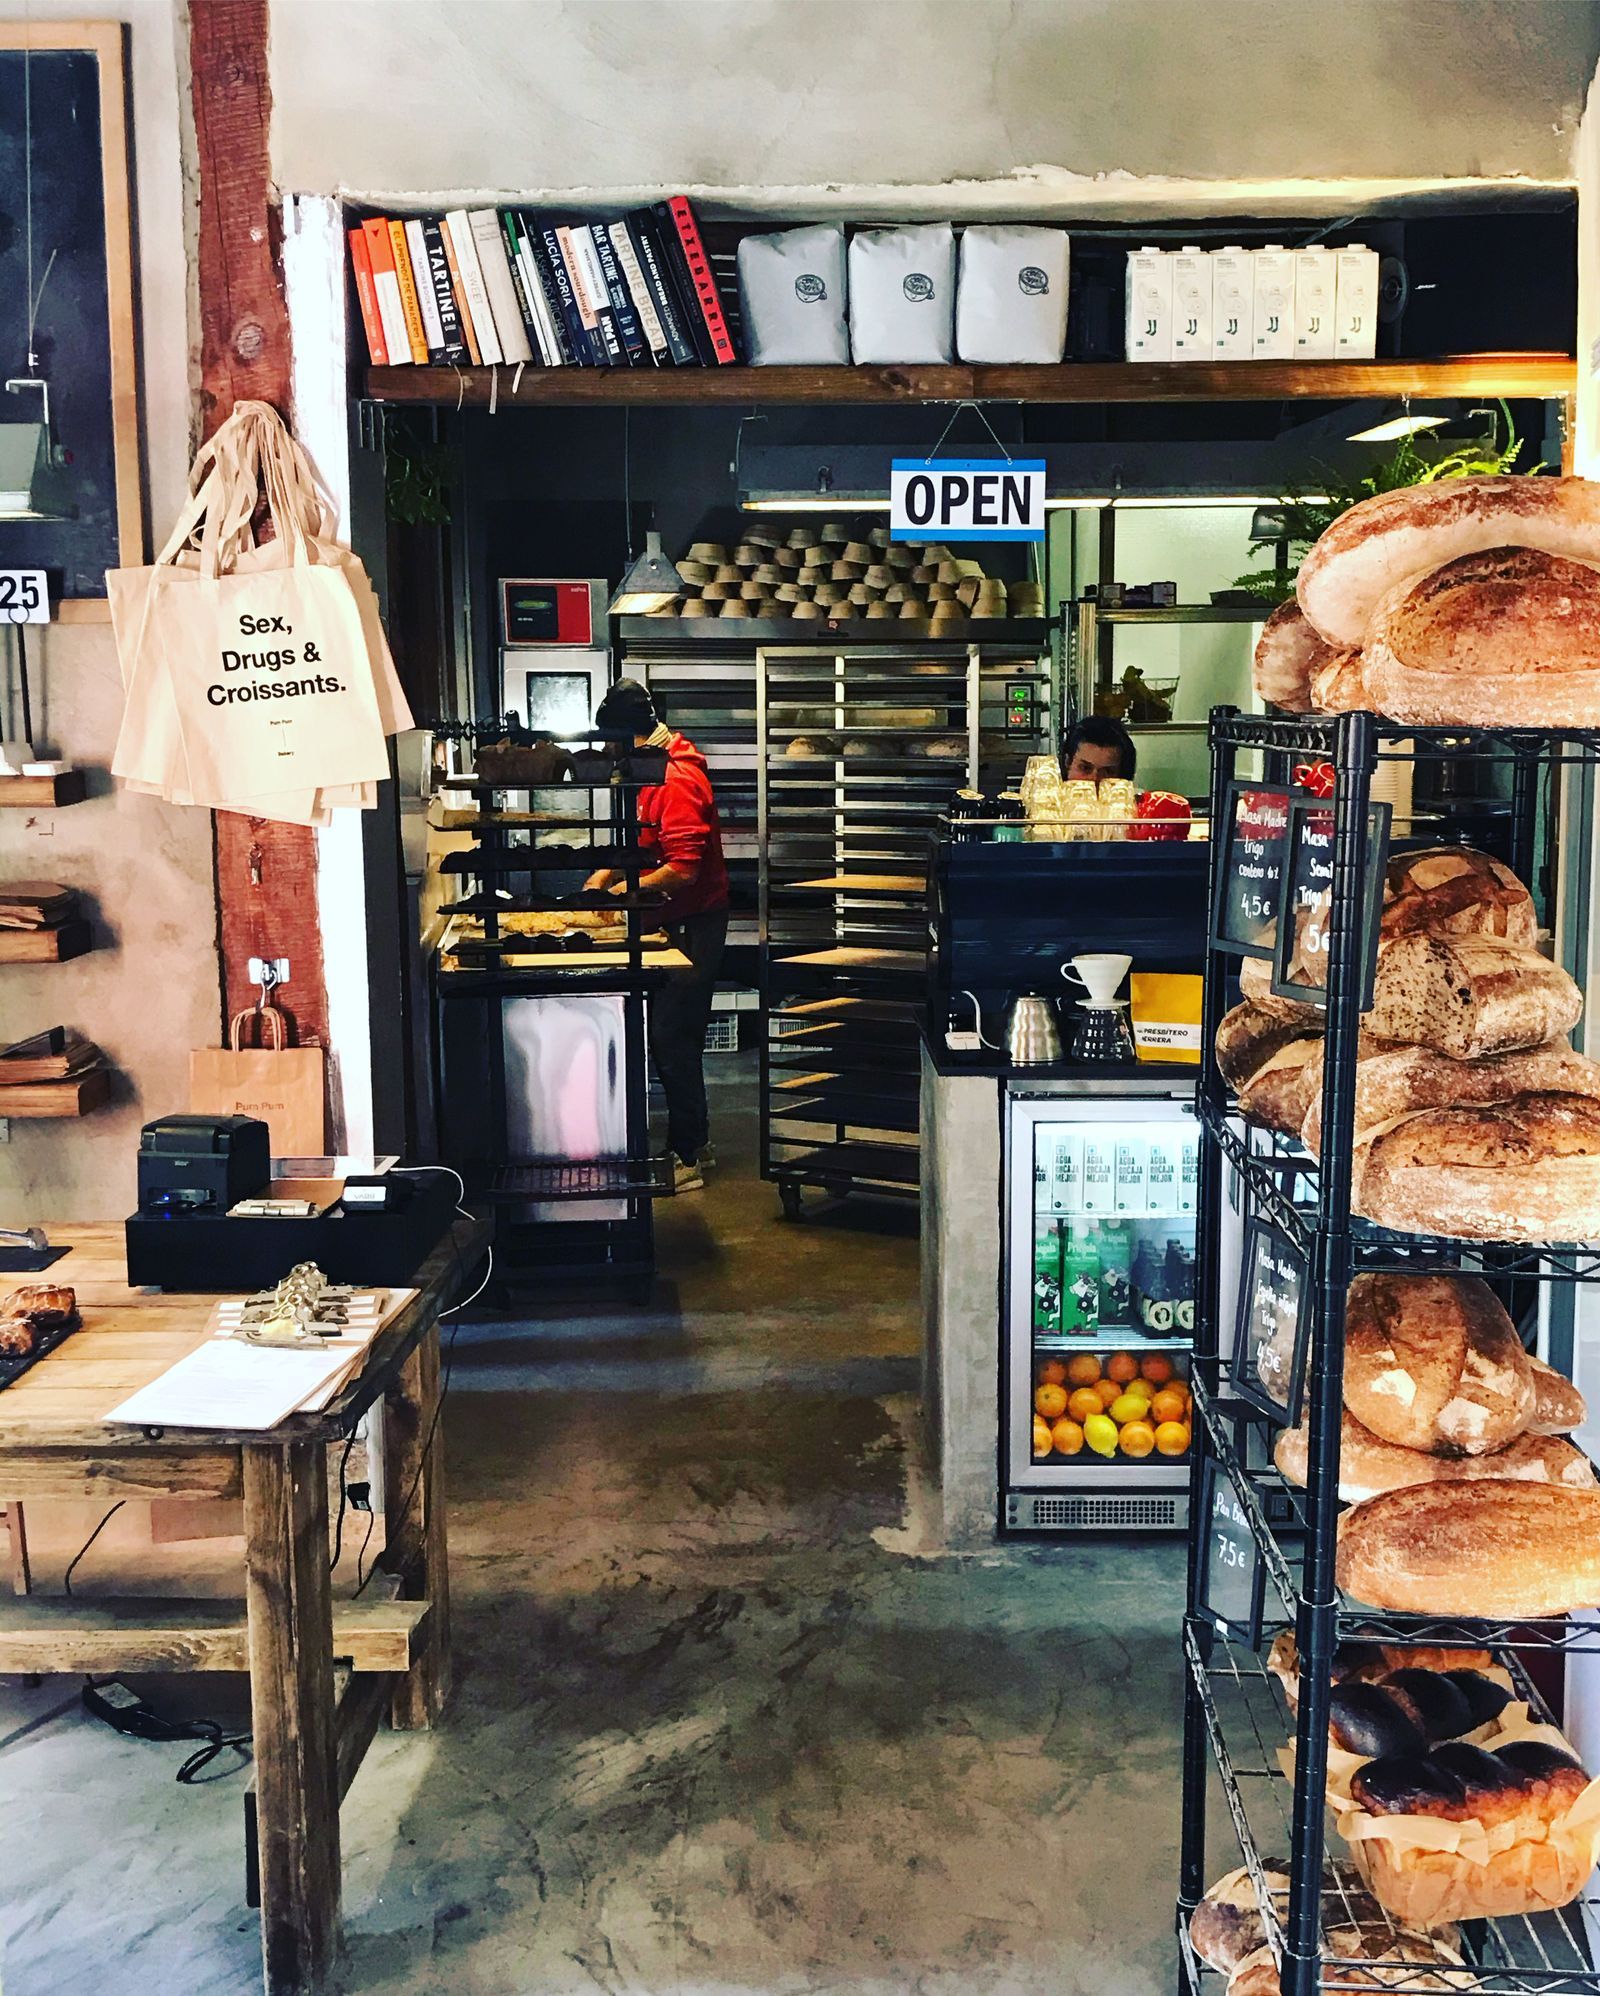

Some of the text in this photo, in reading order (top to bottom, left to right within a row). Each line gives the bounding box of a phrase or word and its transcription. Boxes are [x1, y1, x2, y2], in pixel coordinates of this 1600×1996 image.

[590, 223, 607, 244] BAR
[639, 233, 655, 263] PASTRY
[541, 229, 573, 307] LUCÍA SORIA
[561, 235, 577, 271] modern
[570, 271, 592, 319] sourdough
[596, 243, 619, 282] TARTINE
[648, 262, 660, 280] AND
[677, 209, 721, 332] ETXEBARRI
[429, 246, 456, 322] TARTINE
[466, 270, 483, 306] SWEET
[613, 222, 643, 291] TARTINE
[638, 294, 663, 348] BREAD
[654, 279, 668, 306] BREAD
[600, 314, 620, 355] EL PAN
[662, 304, 680, 342] ADVANCED
[905, 475, 1031, 525] OPEN
[239, 614, 293, 636] Sex,
[221, 641, 322, 672] Drugs &
[207, 674, 346, 706] Croissants.
[1264, 809, 1287, 829] Madre
[235, 1101, 284, 1111] Pum Pum
[1216, 1491, 1230, 1518] Pan
[1217, 1533, 1246, 1569] 7,5€
